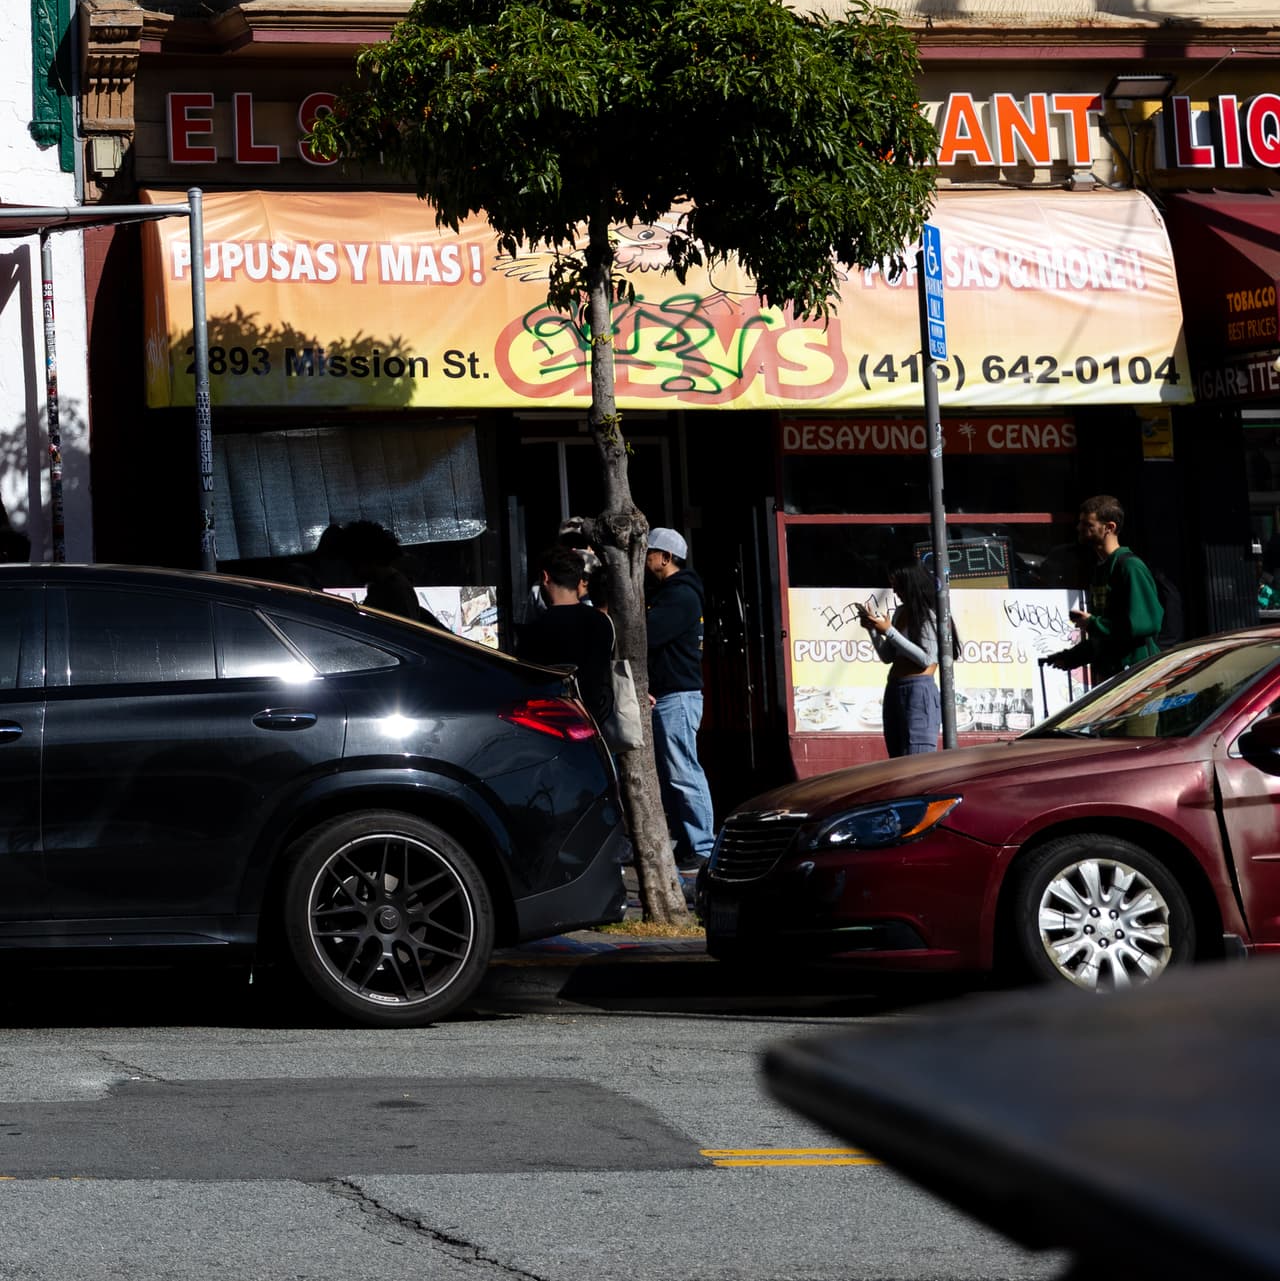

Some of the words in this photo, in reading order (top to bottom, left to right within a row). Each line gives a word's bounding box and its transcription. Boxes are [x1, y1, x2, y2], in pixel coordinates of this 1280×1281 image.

[166, 92, 280, 164] EL
[345, 243, 370, 281] Y
[380, 244, 462, 283] MAS
[1040, 248, 1128, 288] MORE
[1226, 286, 1276, 312] TOBACCO
[285, 348, 429, 379] Mission
[443, 350, 489, 379] St.
[981, 354, 1181, 386] 642-0104
[987, 423, 1077, 450] CENAS
